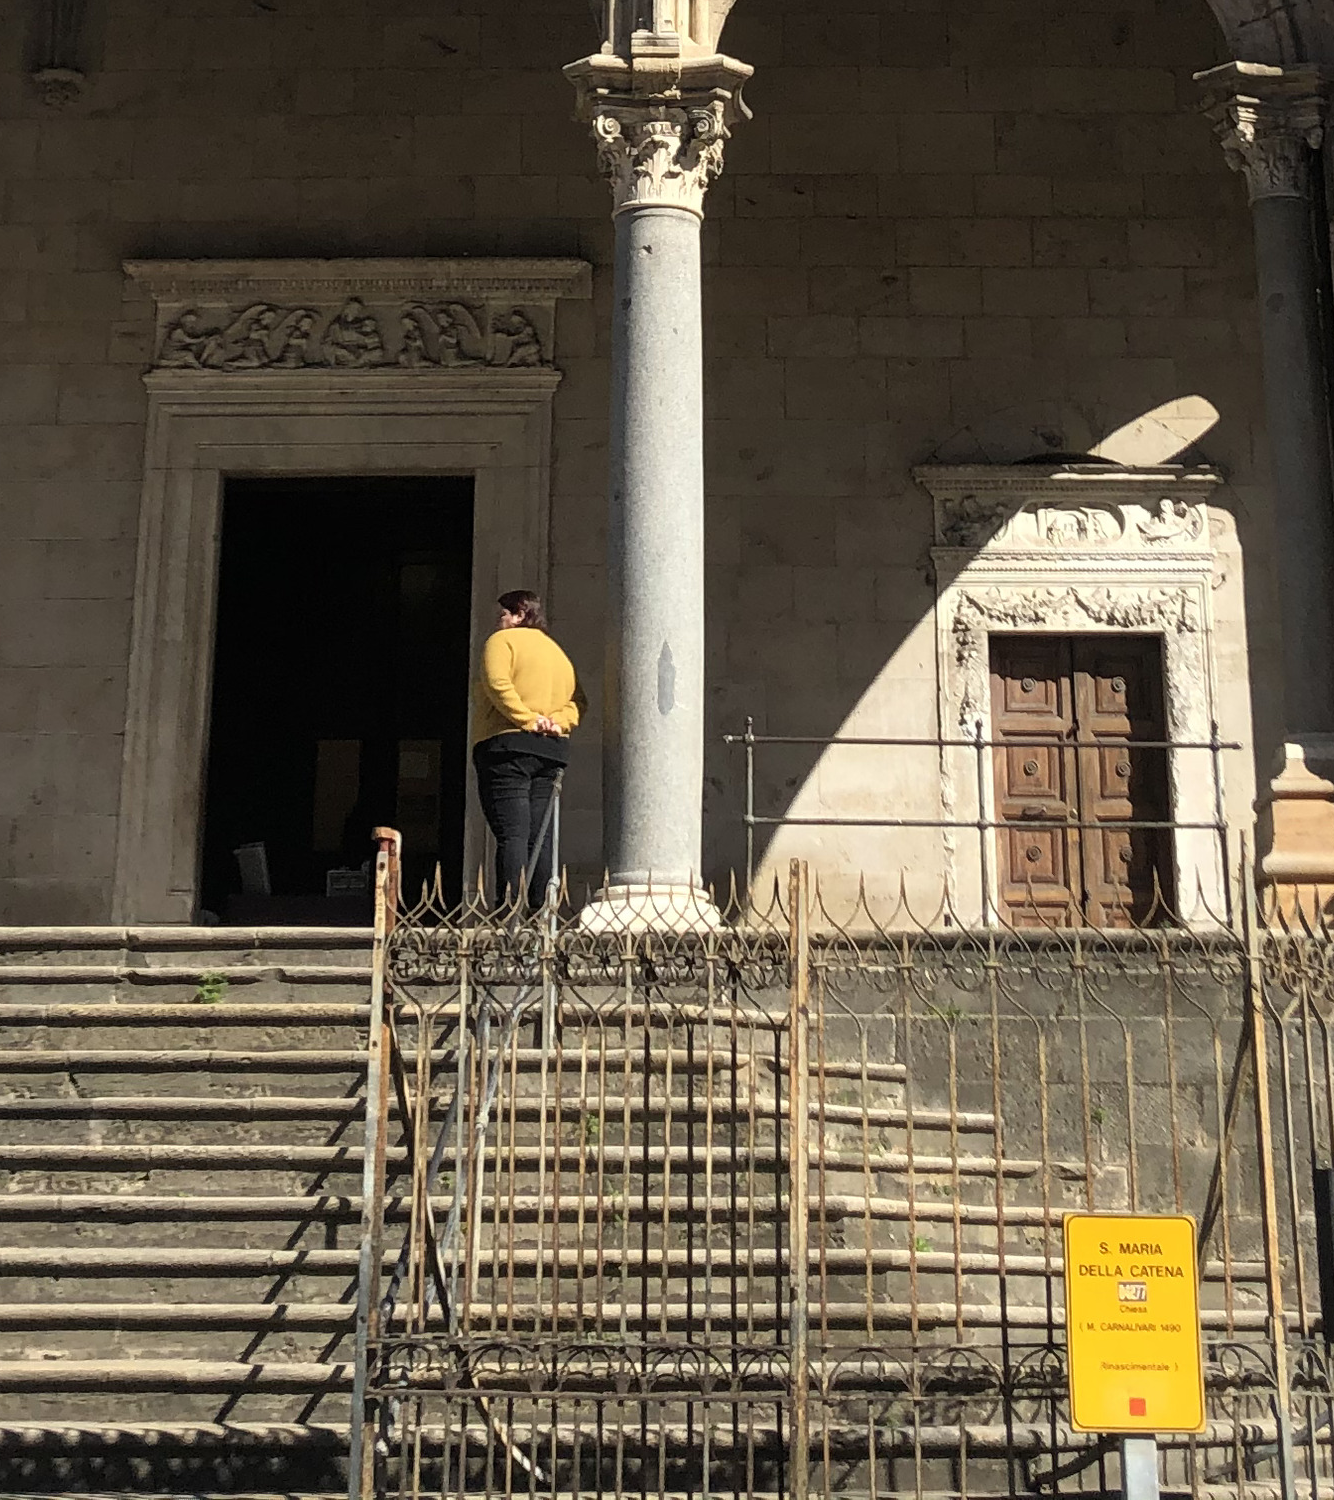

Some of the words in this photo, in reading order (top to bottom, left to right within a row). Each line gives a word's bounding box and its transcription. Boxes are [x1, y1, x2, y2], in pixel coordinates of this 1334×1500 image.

[1118, 1242, 1163, 1255] MARIA
[1078, 1264, 1124, 1277] DELLA
[1129, 1264, 1185, 1278] CATENA
[1119, 1304, 1148, 1314] Chiesa
[1160, 1323, 1182, 1333] 1490
[1101, 1361, 1170, 1371] Rinascimentale
